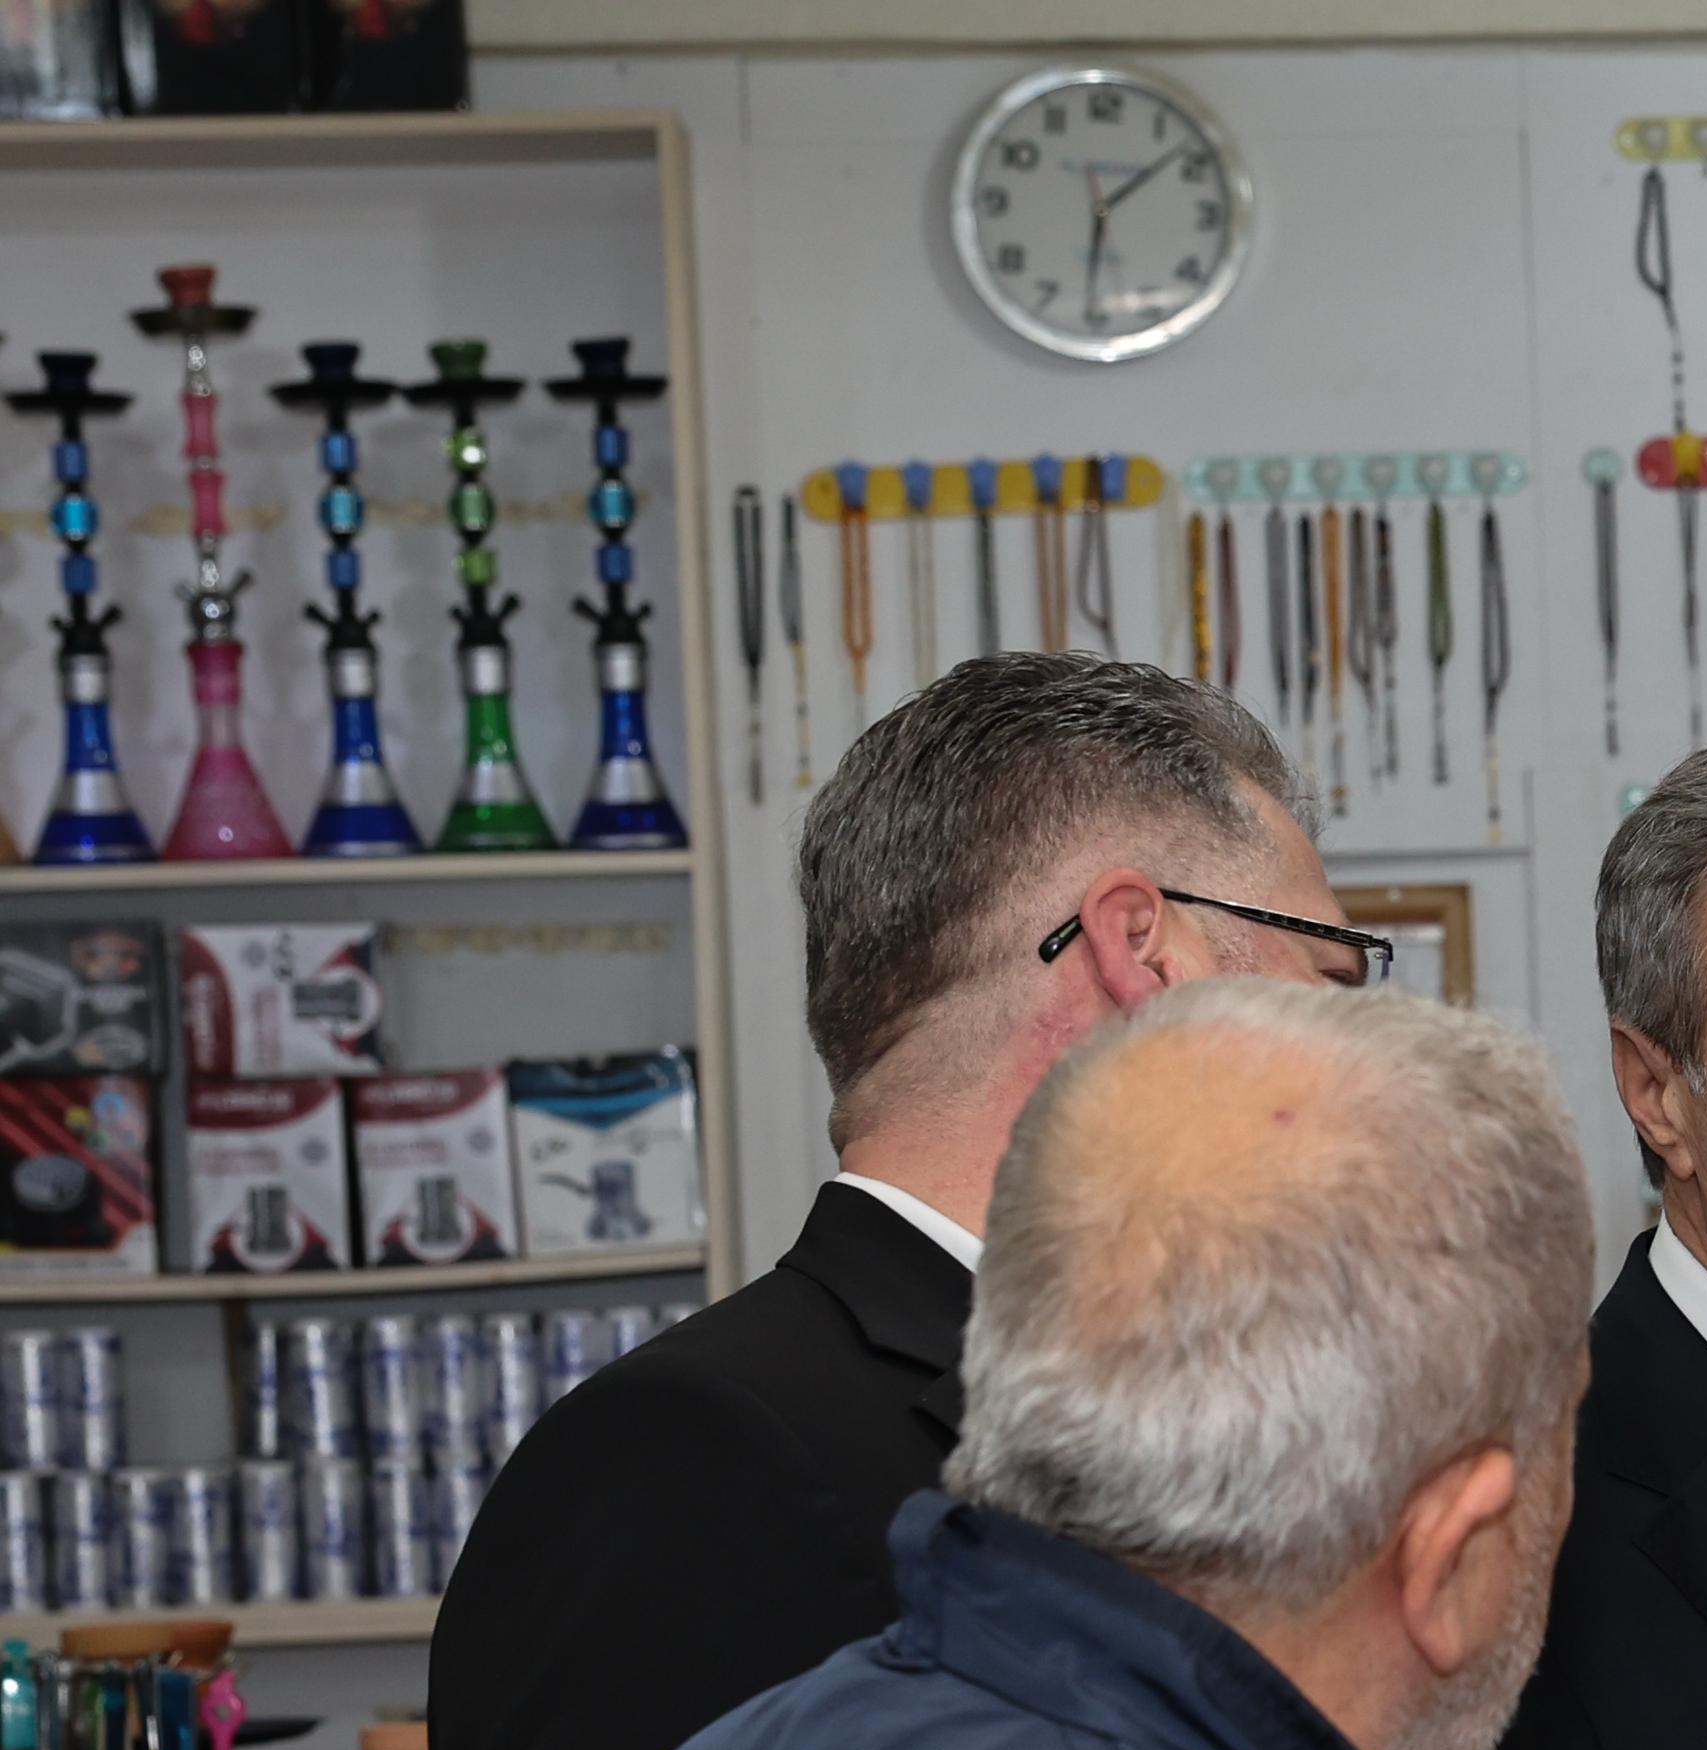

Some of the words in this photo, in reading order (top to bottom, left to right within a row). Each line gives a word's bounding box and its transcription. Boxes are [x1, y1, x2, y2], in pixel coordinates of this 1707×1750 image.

[1088, 90, 1124, 124] 12
[1001, 140, 1039, 172] 10
[982, 185, 1008, 218] 9
[1196, 199, 1221, 232] 3
[1173, 255, 1209, 286] 4
